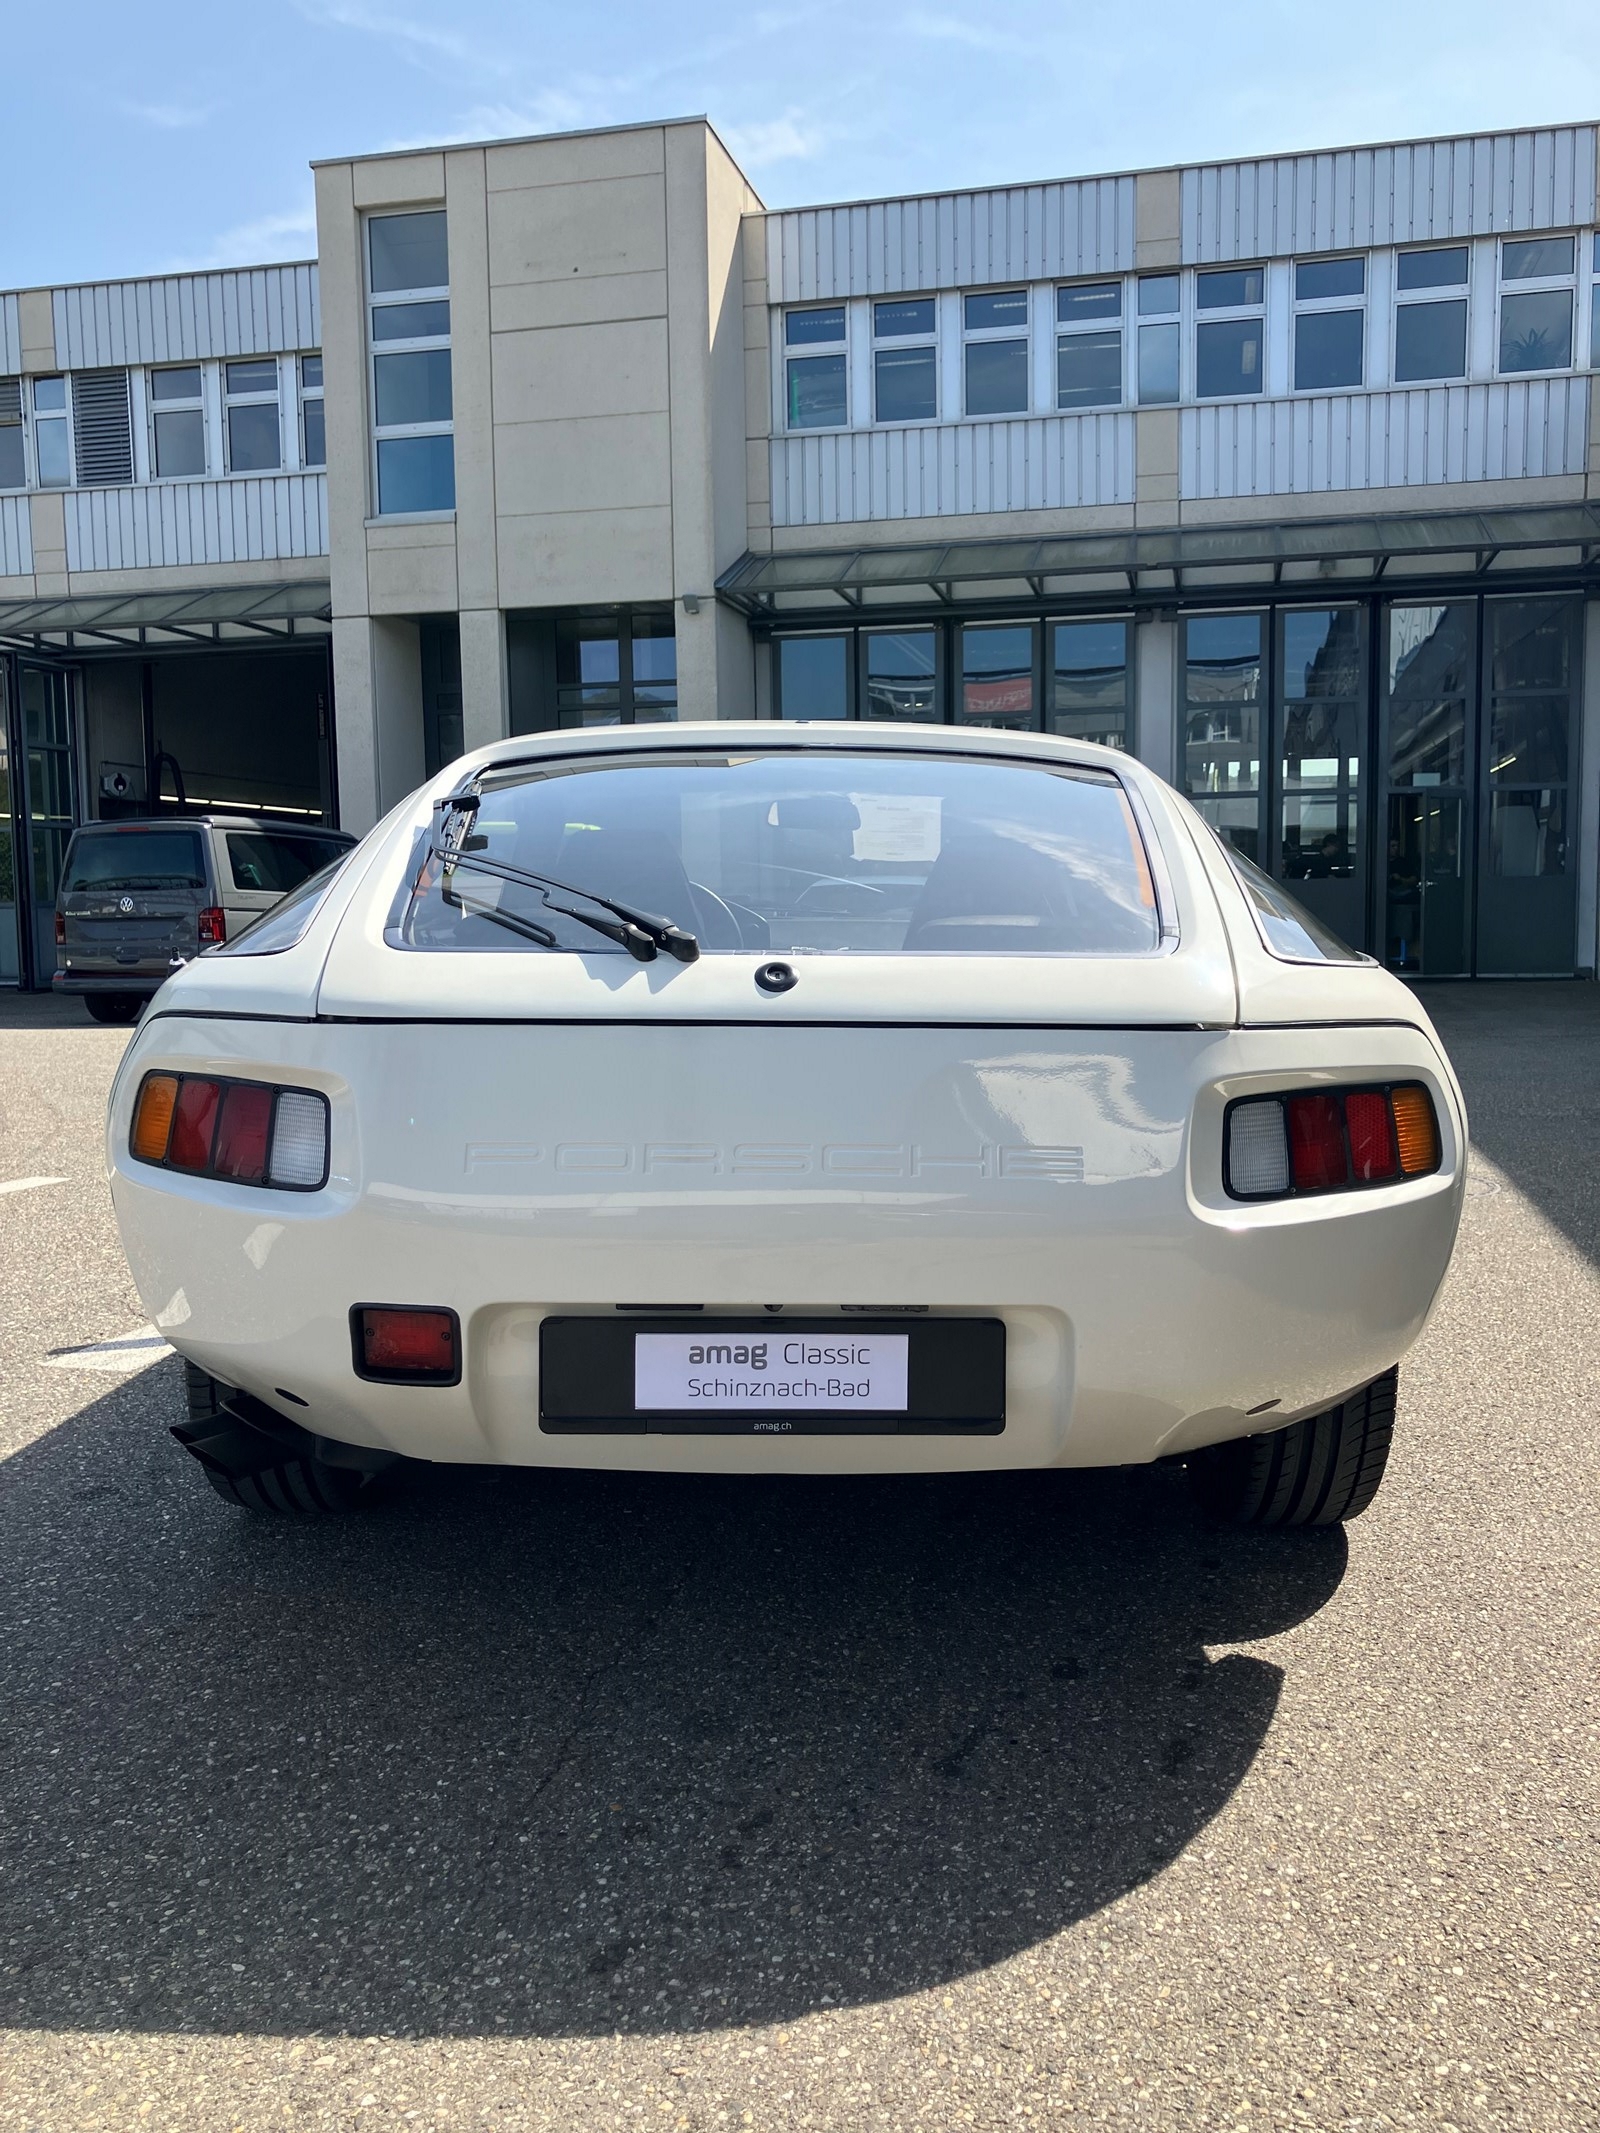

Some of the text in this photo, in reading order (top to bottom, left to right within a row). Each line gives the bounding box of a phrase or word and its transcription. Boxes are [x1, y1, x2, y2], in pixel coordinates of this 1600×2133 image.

[464, 1141, 1084, 1180] PORSCHE
[688, 1342, 871, 1370] amag Classic
[687, 1377, 871, 1398] Schinznach-Bad
[753, 1421, 792, 1432] amag.ch
